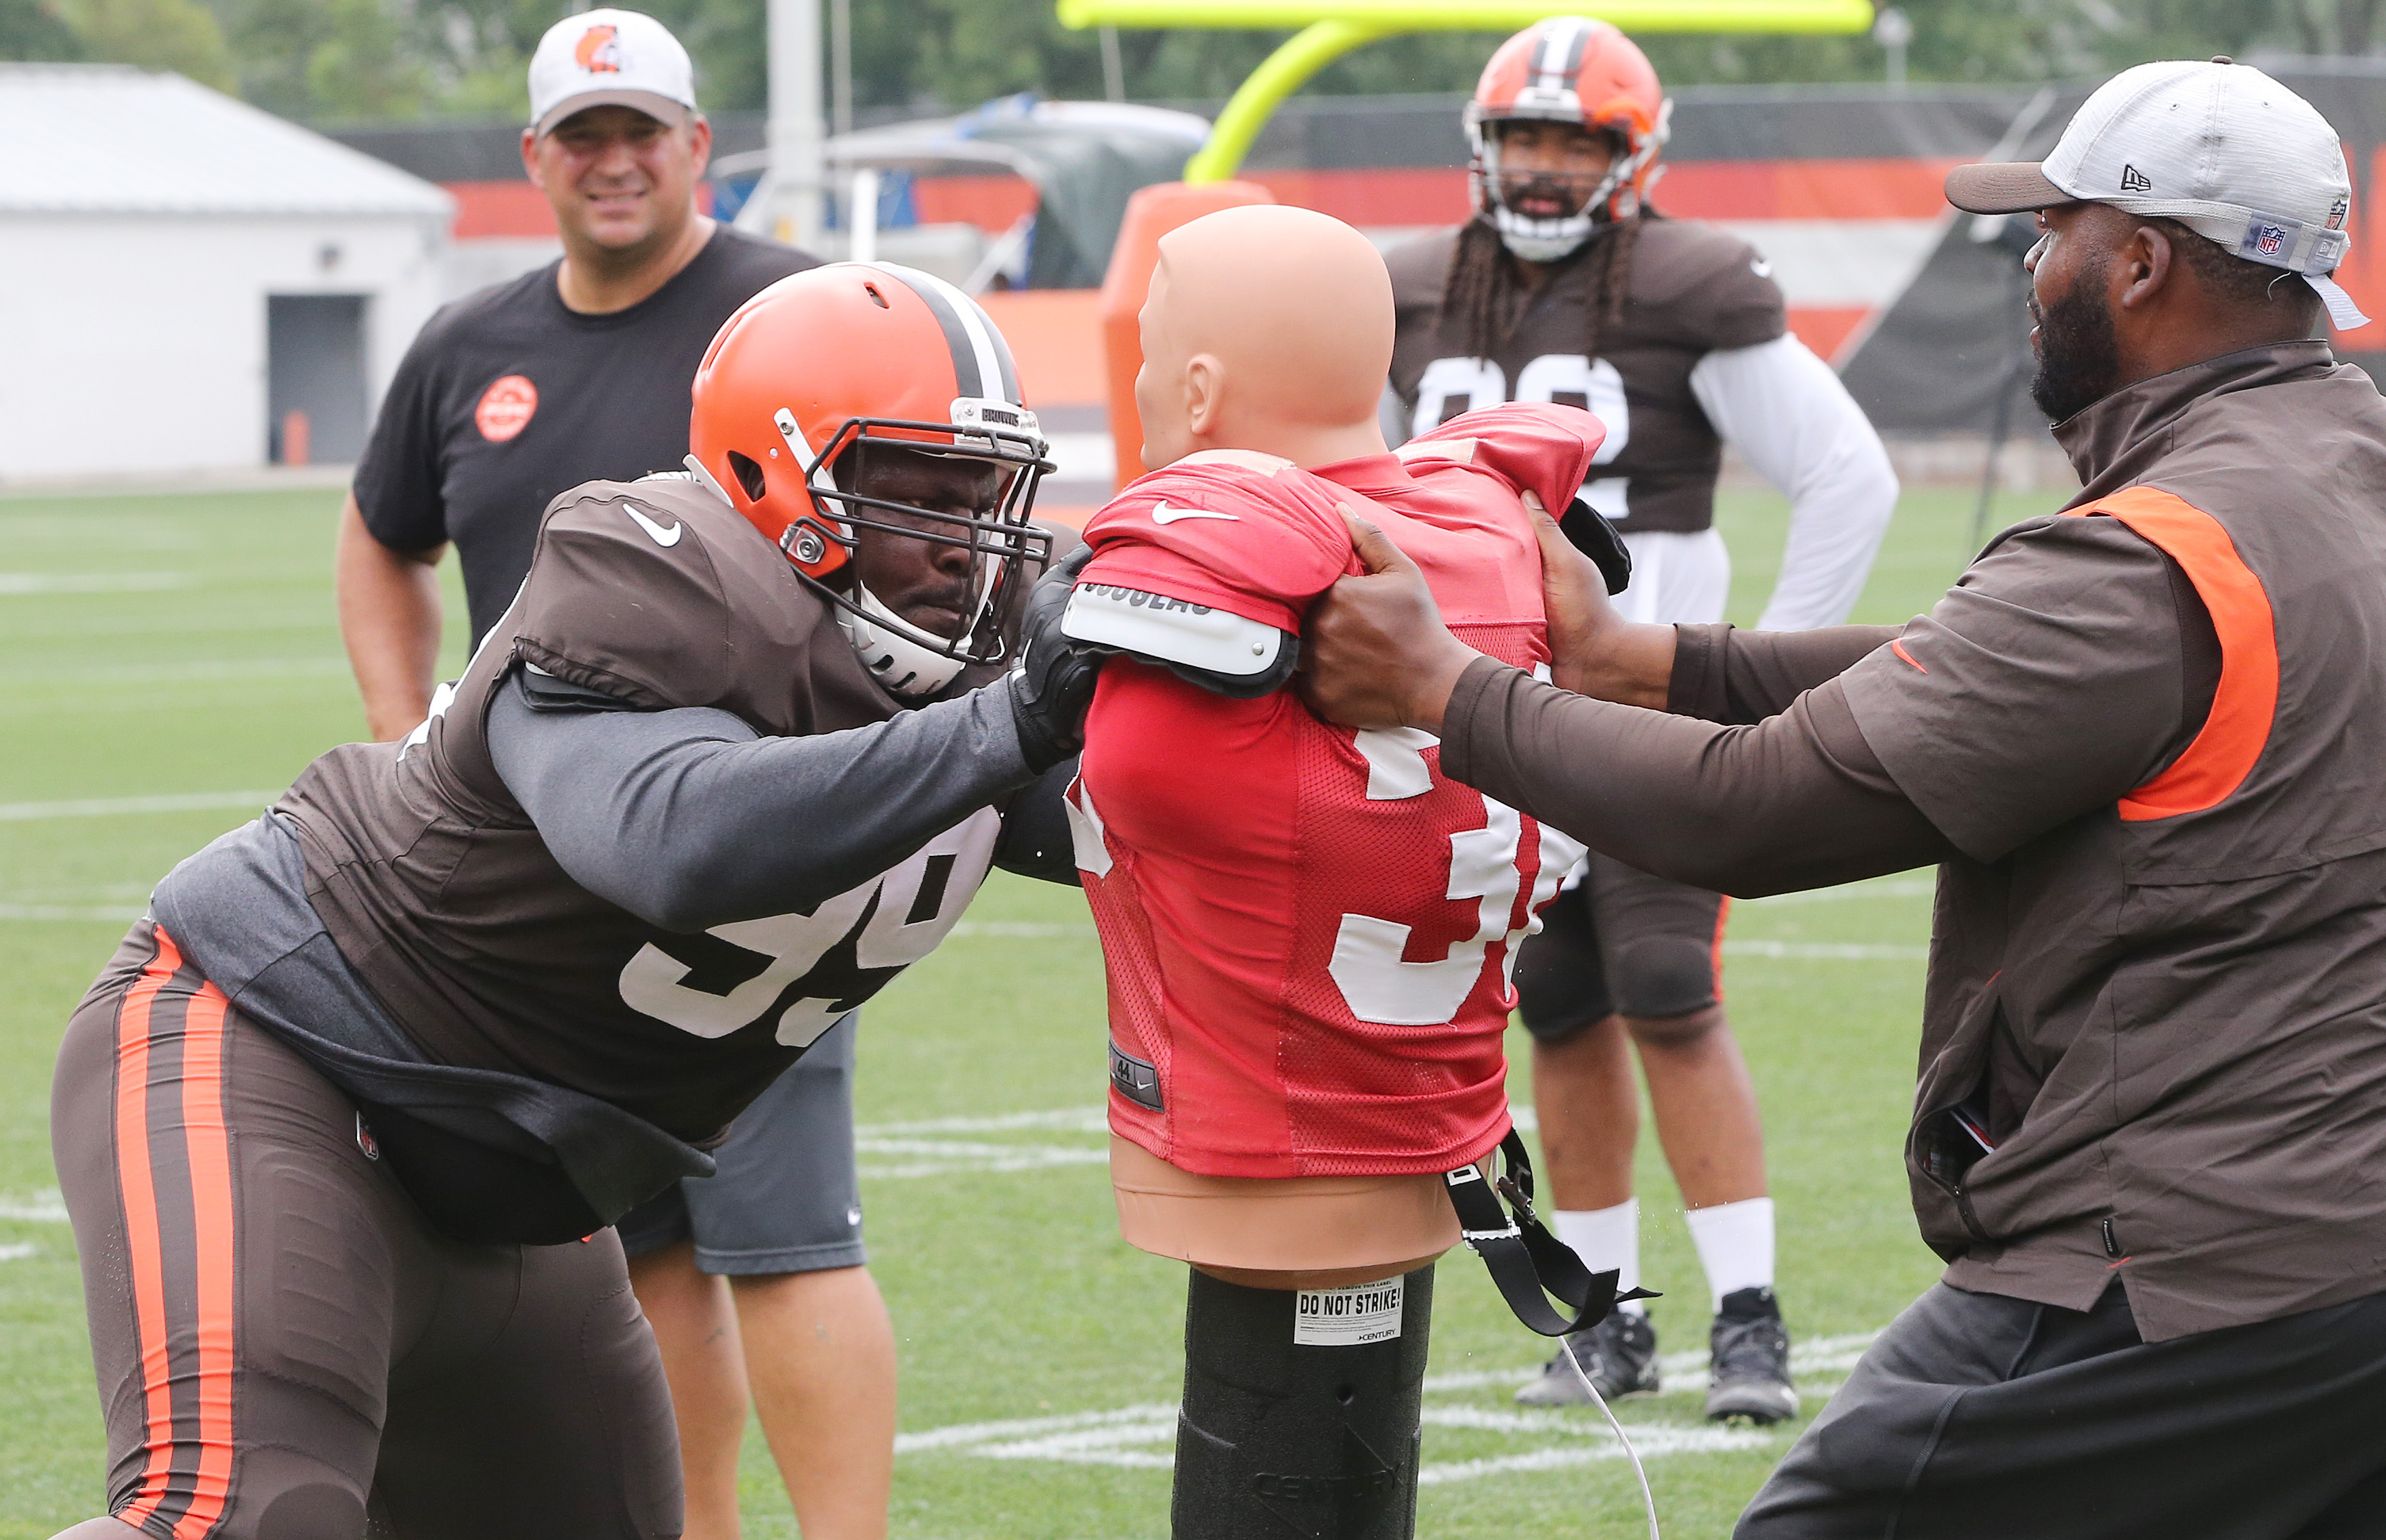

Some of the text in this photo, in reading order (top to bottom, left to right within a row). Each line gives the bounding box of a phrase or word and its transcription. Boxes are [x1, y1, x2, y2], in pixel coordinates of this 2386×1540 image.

[2259, 237, 2278, 252] NFL
[1117, 1060, 1130, 1081] 44
[1300, 1295, 1319, 1314] DO
[1324, 1296, 1351, 1314] NOT
[1356, 1288, 1401, 1314] STRIKE!
[1363, 1329, 1395, 1340] CENTURY
